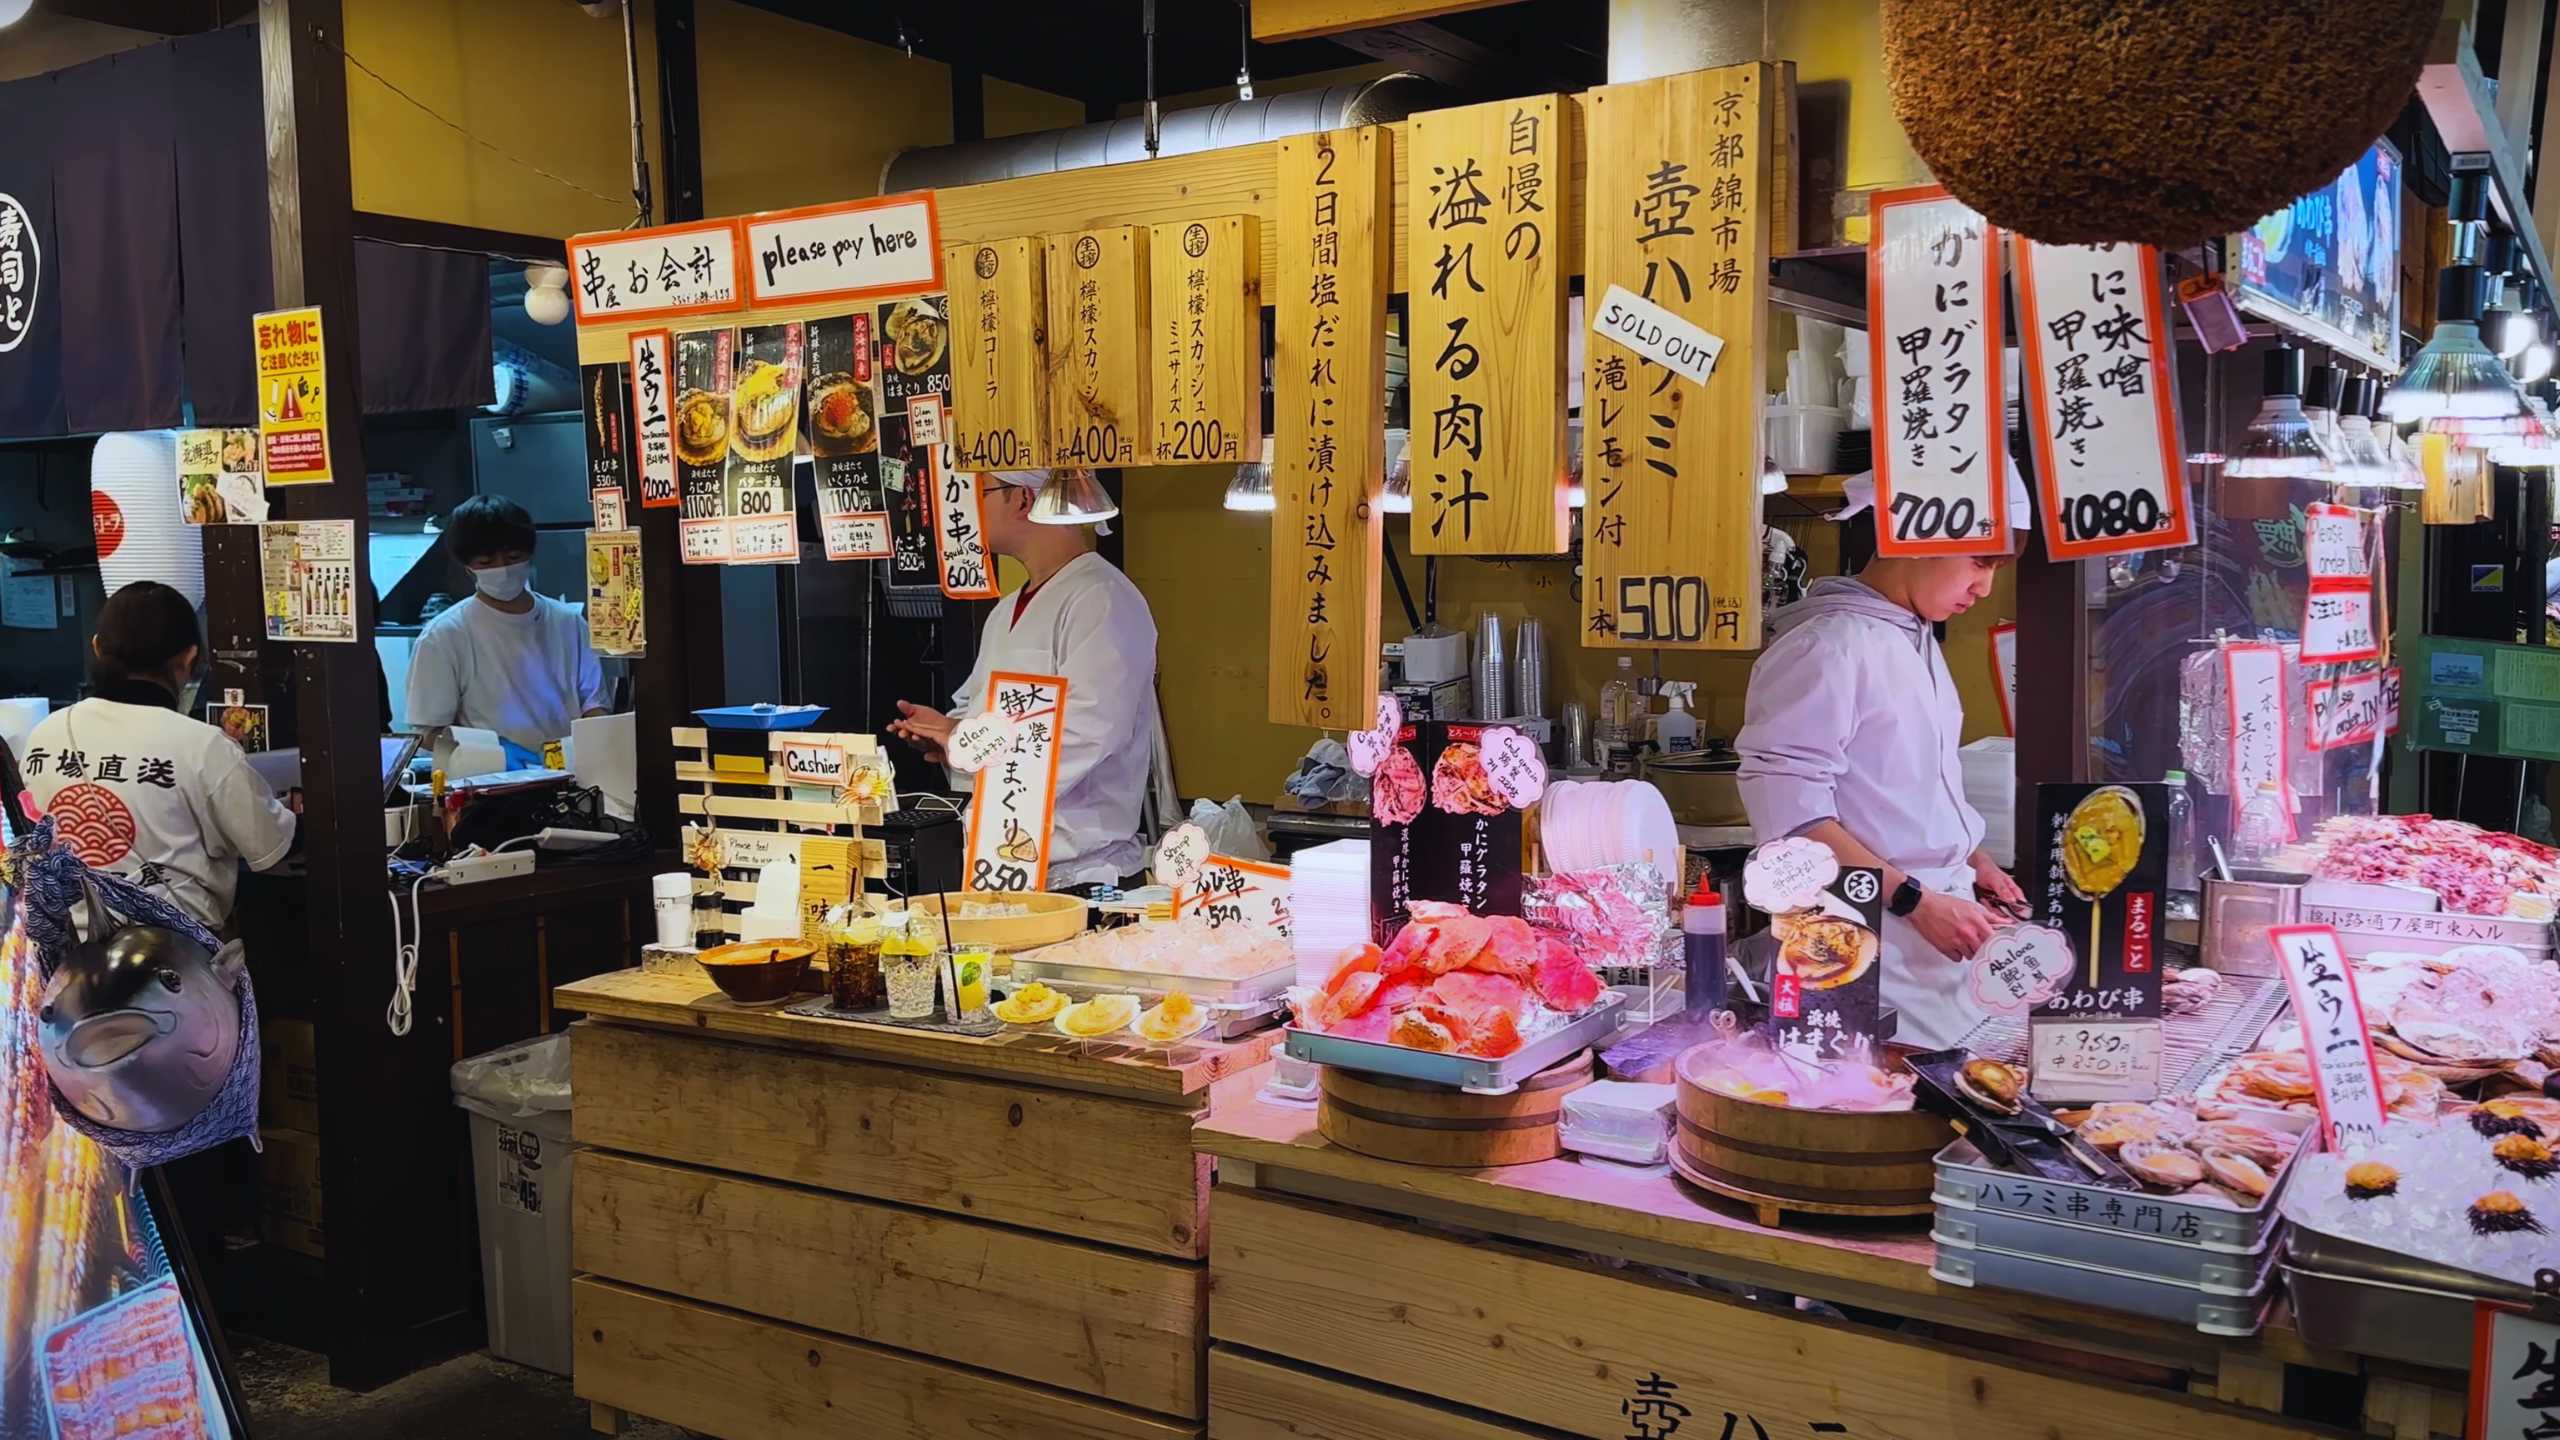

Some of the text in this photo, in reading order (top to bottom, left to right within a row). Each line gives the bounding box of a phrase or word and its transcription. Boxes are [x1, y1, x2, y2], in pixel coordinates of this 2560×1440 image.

[1502, 107, 1545, 261] 自慢の
[1709, 91, 1744, 295] 京都錦市場
[762, 223, 918, 287] please pay here
[258, 320, 318, 350] 忘れ物に
[1428, 158, 1491, 542] 溢れる肉汁
[1605, 304, 1713, 372] SOLD OUT
[1932, 226, 1978, 474] かにグラタン
[2089, 241, 2152, 398] に味噌
[639, 339, 666, 427] 生ウニ
[927, 374, 951, 393] 850
[1169, 320, 1182, 414] ミニサイズ
[828, 472, 869, 487] いくらのせ
[1594, 354, 1628, 548] 滝レモン付
[689, 480, 721, 494] うにのせ
[741, 490, 772, 515] 800
[26, 747, 176, 789] 市場直送
[787, 750, 842, 774] Cashier
[974, 860, 1029, 892] 850
[1475, 818, 1488, 909] かにグラタン
[1989, 942, 2035, 976] Abalone
[2129, 898, 2149, 968] まるごと
[2048, 986, 2144, 1011] あわび串
[2300, 939, 2360, 1054] 生ウニ
[1979, 1183, 2201, 1239] ハラミ串専門店
